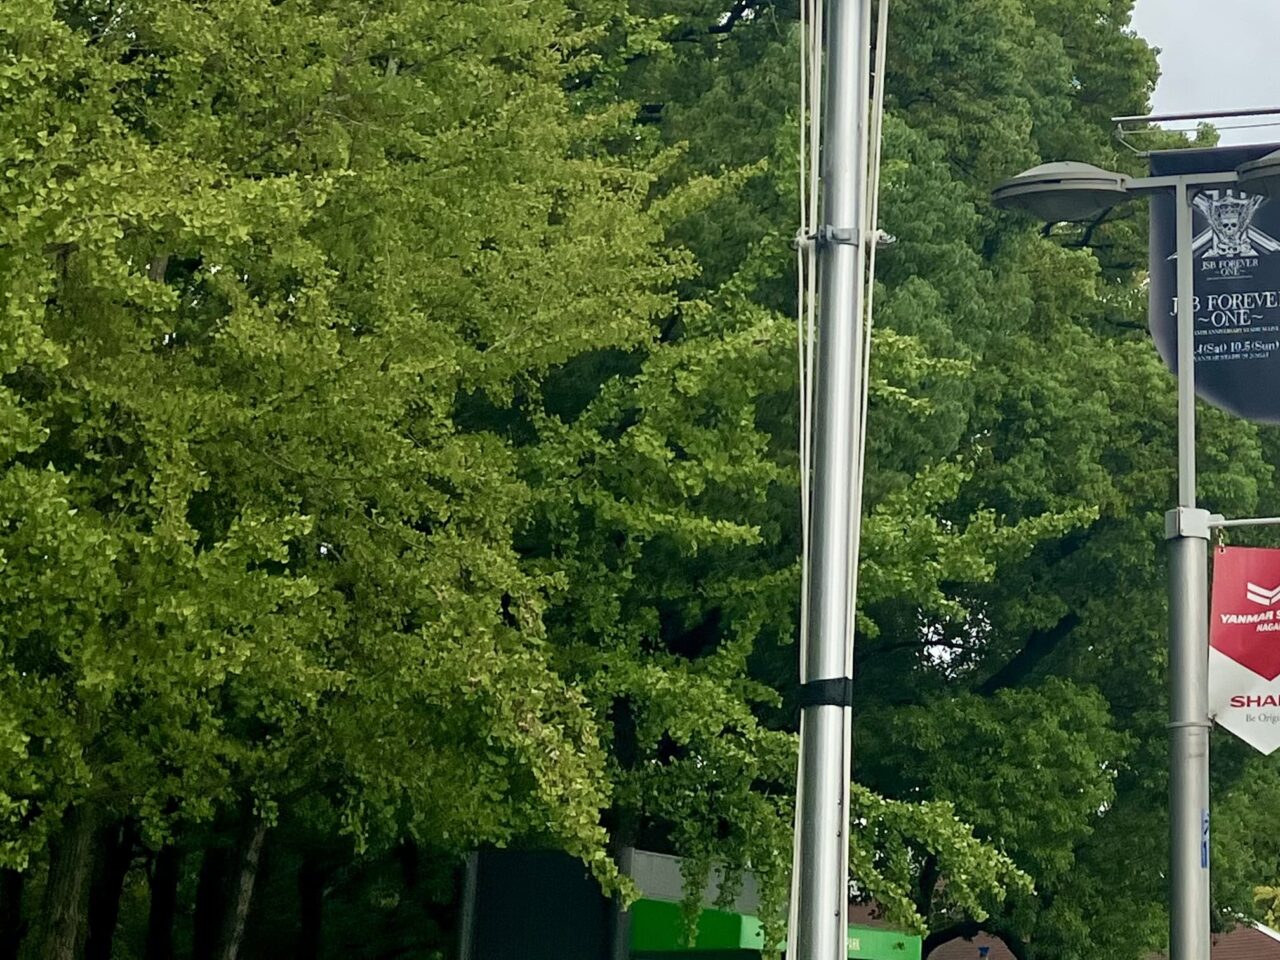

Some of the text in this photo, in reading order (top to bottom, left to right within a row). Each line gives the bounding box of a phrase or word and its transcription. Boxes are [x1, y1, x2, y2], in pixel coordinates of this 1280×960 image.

[1170, 295, 1201, 316] JB
[1220, 611, 1275, 624] YANMAR
[1246, 713, 1256, 723] Be
